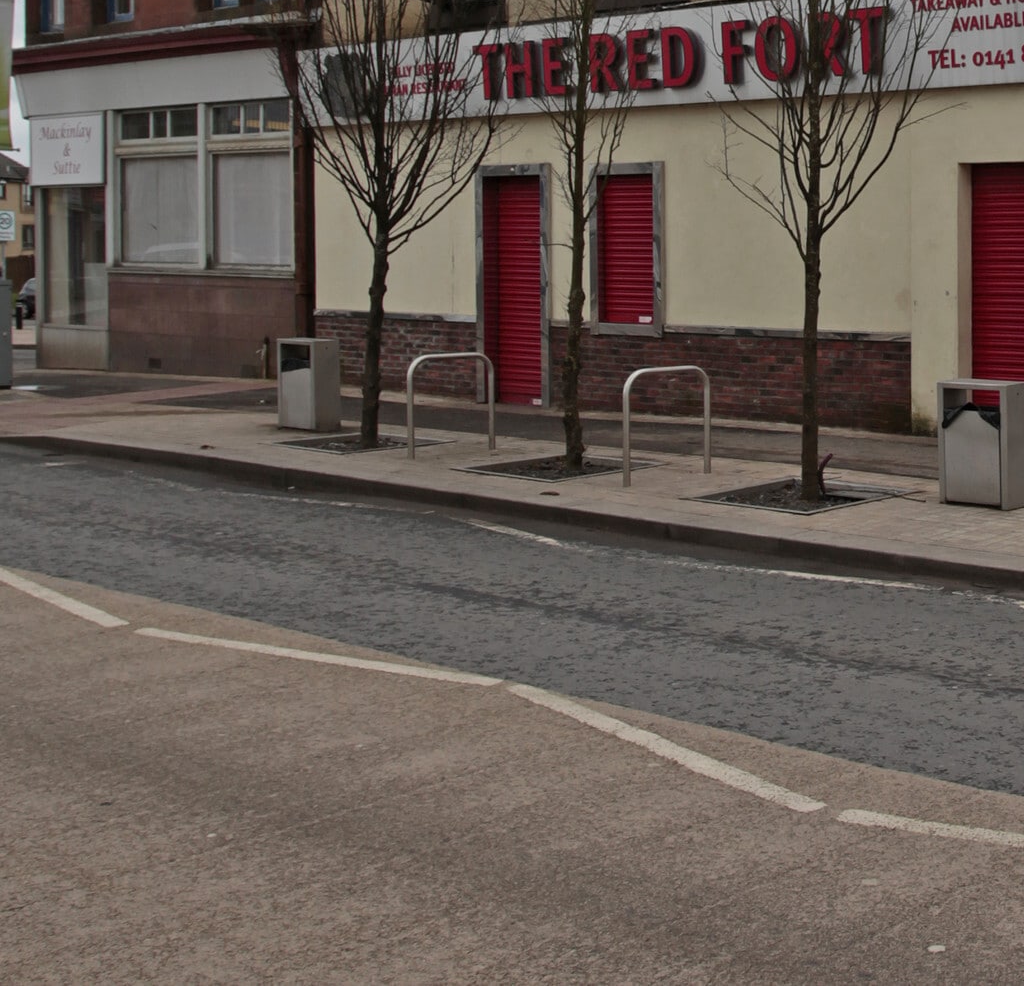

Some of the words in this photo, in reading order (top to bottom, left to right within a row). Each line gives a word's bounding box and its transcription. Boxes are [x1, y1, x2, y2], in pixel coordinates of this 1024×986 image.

[472, 37, 568, 100] THE
[588, 26, 698, 93] RED
[927, 49, 967, 70] TEL:
[972, 48, 1015, 70] 0141
[38, 122, 92, 142] Mackinlay
[62, 143, 72, 158] &
[52, 161, 82, 176] Suttie
